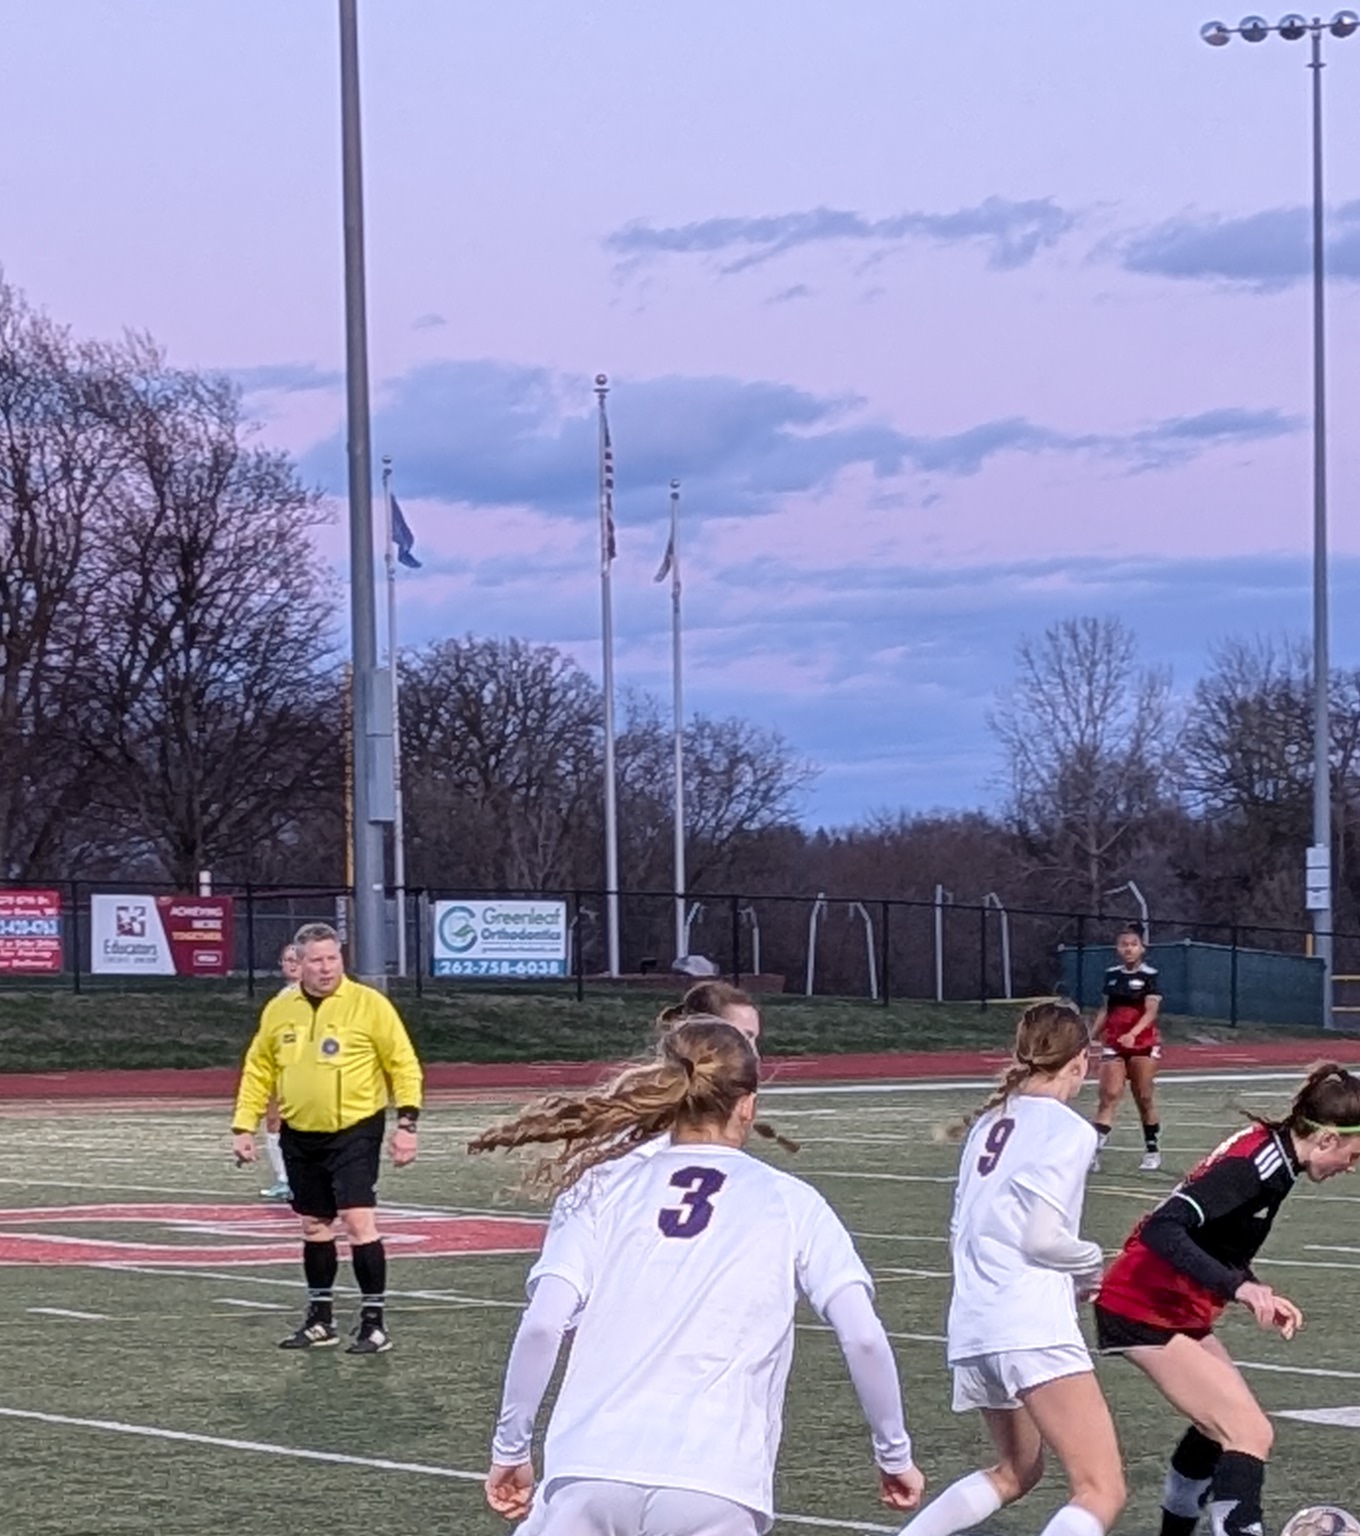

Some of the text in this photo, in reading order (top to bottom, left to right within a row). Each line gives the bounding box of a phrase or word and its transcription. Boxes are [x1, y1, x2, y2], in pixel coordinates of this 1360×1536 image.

[482, 907, 560, 925] Greenleaf
[481, 928, 561, 940] Orthodontics
[103, 939, 158, 955] Educators
[440, 960, 560, 974] 262-758-6038
[977, 1118, 1015, 1177] 9
[658, 1166, 728, 1239] 3
